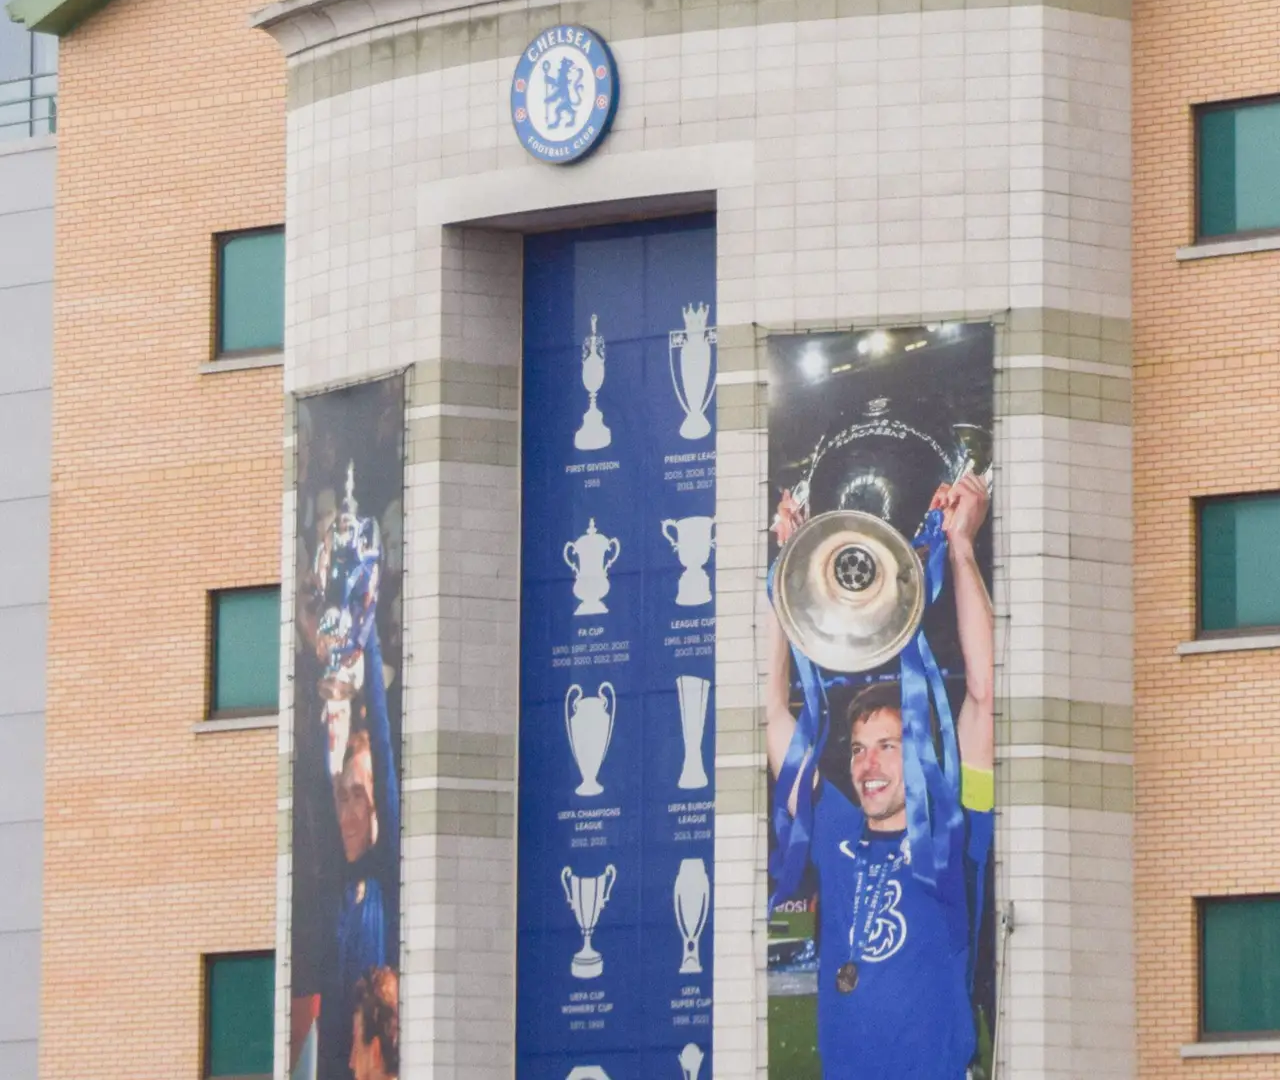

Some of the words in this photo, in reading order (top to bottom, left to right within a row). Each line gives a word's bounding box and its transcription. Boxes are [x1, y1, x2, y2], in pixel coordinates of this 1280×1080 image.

[527, 28, 592, 62] CHELSEA
[527, 136, 570, 157] FOOTBALL
[664, 454, 697, 465] PREMIER
[565, 463, 585, 473] FIRST
[586, 460, 620, 472] DIVISION
[671, 619, 699, 629] LEAGUE
[700, 617, 716, 627] CUP
[578, 628, 588, 637] FA
[588, 626, 605, 636] CUP
[557, 810, 577, 820] UEFA
[577, 807, 621, 818] CHAMPIONS
[668, 803, 687, 813] UEFA
[677, 813, 707, 824] LEAGUE
[574, 821, 604, 831] LEAGUE
[569, 991, 588, 1002] UEFA
[589, 990, 606, 1000] CUP
[681, 985, 700, 996] UEFA
[597, 1003, 614, 1013] CUP
[670, 999, 695, 1009] SUPER
[695, 997, 713, 1008] CUP
